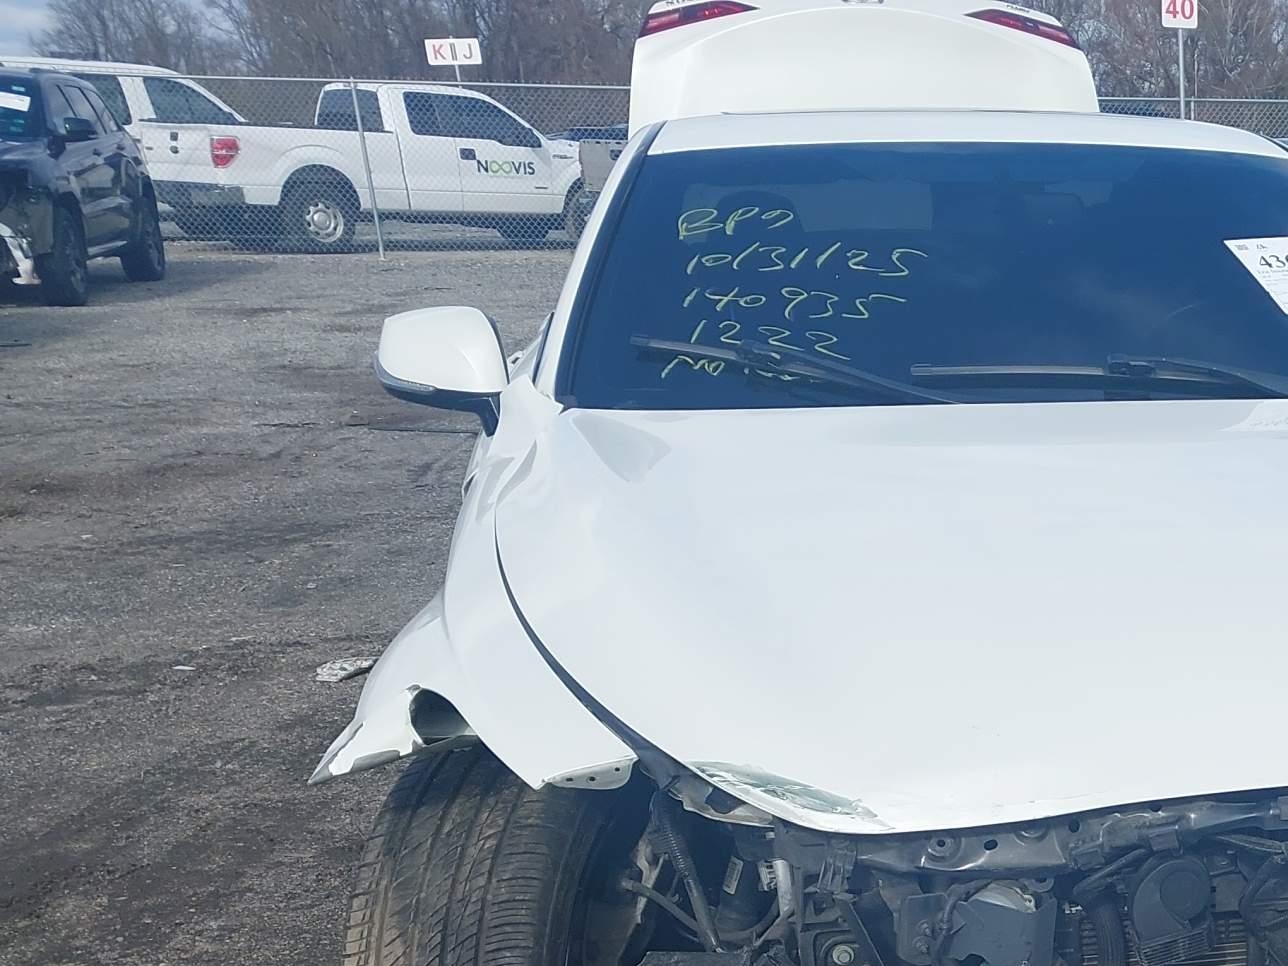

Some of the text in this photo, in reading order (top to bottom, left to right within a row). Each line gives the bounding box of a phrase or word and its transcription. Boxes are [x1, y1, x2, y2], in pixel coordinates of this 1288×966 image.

[1165, 0, 1194, 19] 40
[432, 43, 473, 60] K J
